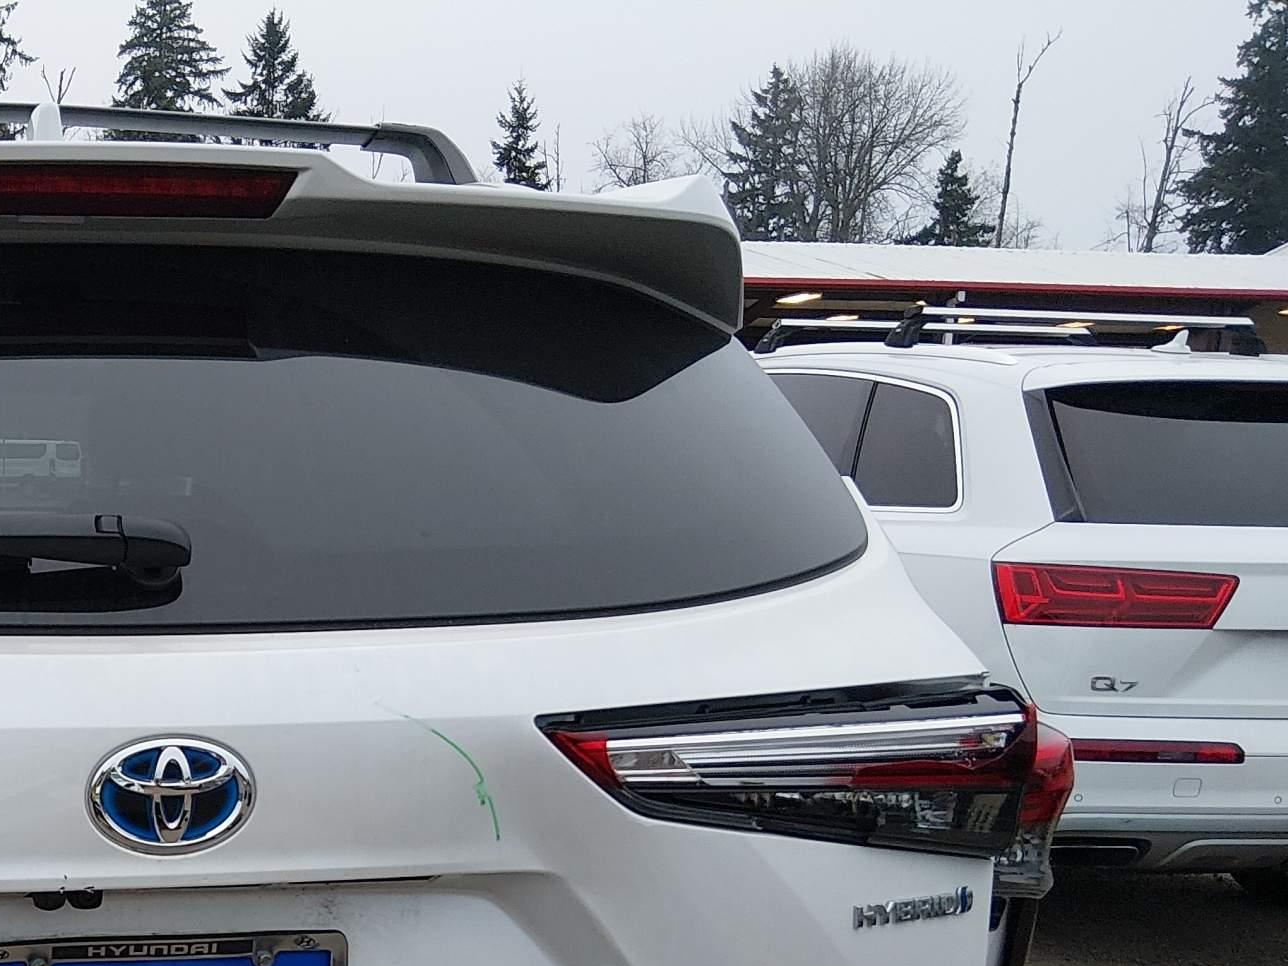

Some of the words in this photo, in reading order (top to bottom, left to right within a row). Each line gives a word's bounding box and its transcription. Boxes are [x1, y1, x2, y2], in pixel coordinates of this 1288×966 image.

[1090, 676, 1139, 693] Q7
[853, 894, 961, 929] HYBRID
[87, 943, 219, 957] HYUNDAI
